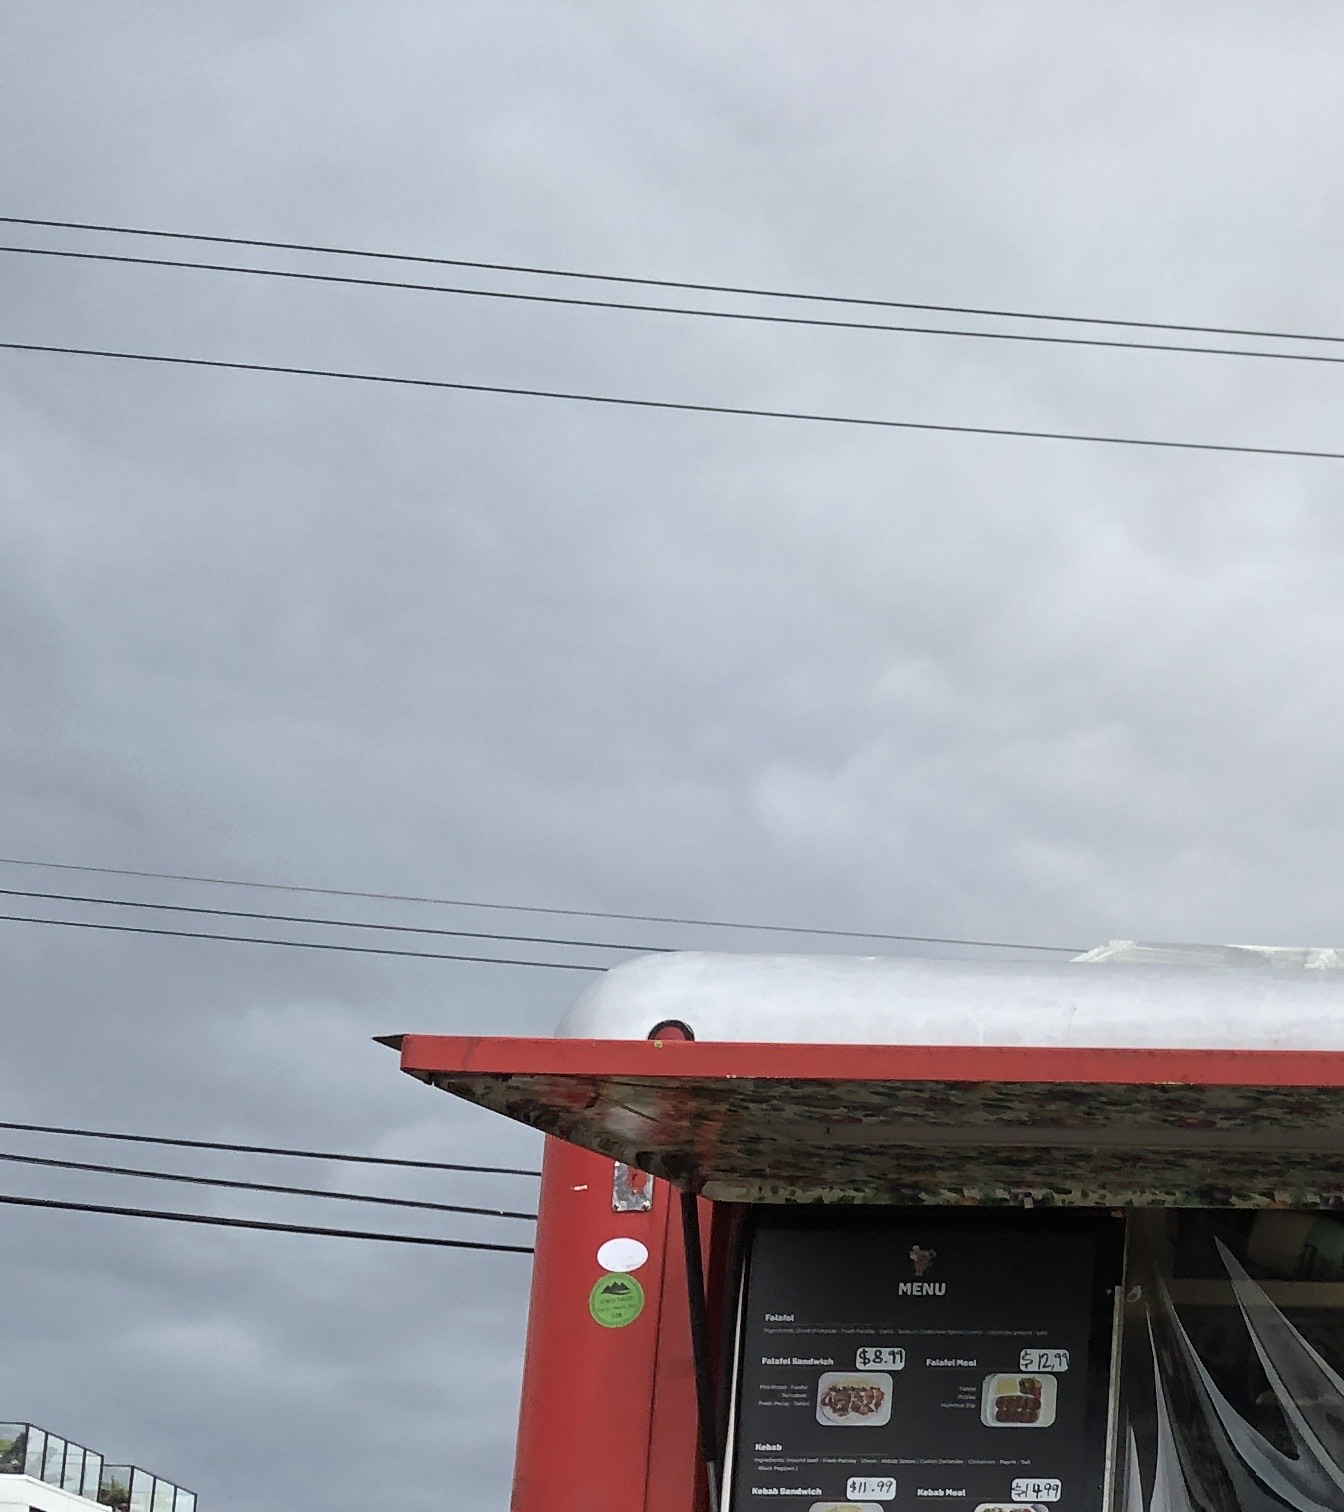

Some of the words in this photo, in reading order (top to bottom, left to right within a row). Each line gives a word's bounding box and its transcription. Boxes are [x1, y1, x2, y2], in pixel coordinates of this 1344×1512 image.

[898, 1282, 946, 1296] MENU
[764, 1313, 795, 1322] Falafel
[858, 1348, 903, 1366] $8.99
[754, 1443, 783, 1451] Kebab
[751, 1487, 779, 1495] Kebab
[849, 1480, 894, 1494] $11.99
[916, 1488, 944, 1497] Kebab
